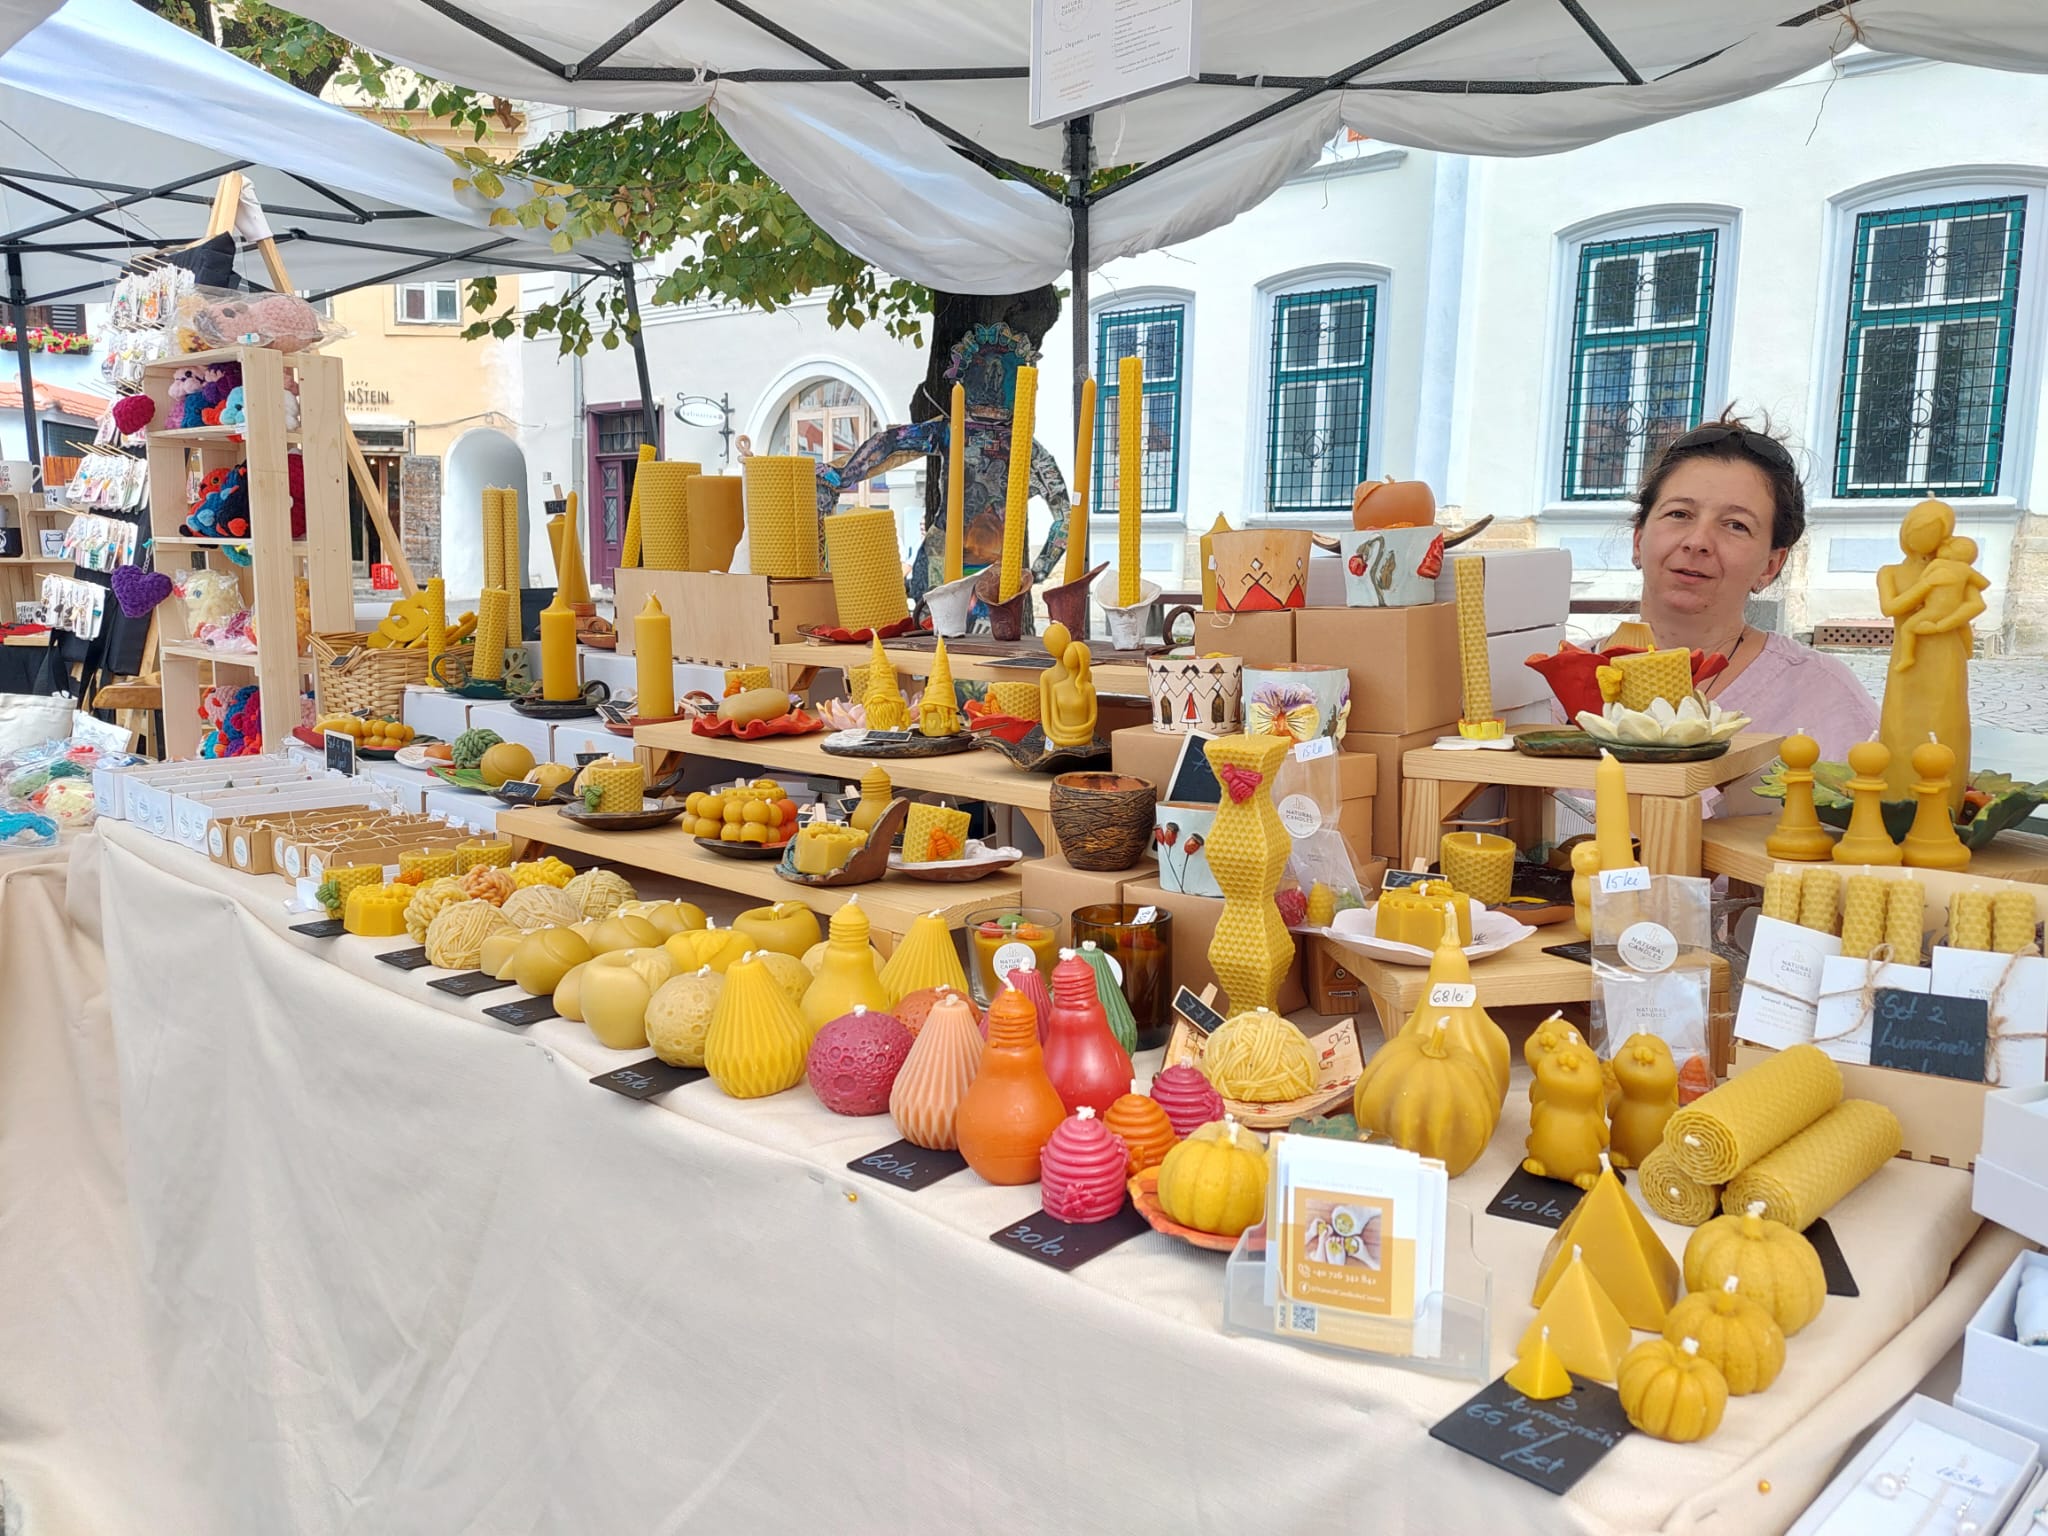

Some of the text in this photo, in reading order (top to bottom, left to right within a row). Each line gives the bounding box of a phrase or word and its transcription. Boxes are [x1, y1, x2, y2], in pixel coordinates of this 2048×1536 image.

[344, 387, 389, 405] NSTEIN
[1628, 942, 1662, 961] CANDLES
[1631, 936, 1665, 956] NATURAL
[1926, 1006, 1947, 1025] 2
[1465, 1403, 1509, 1426] 65
